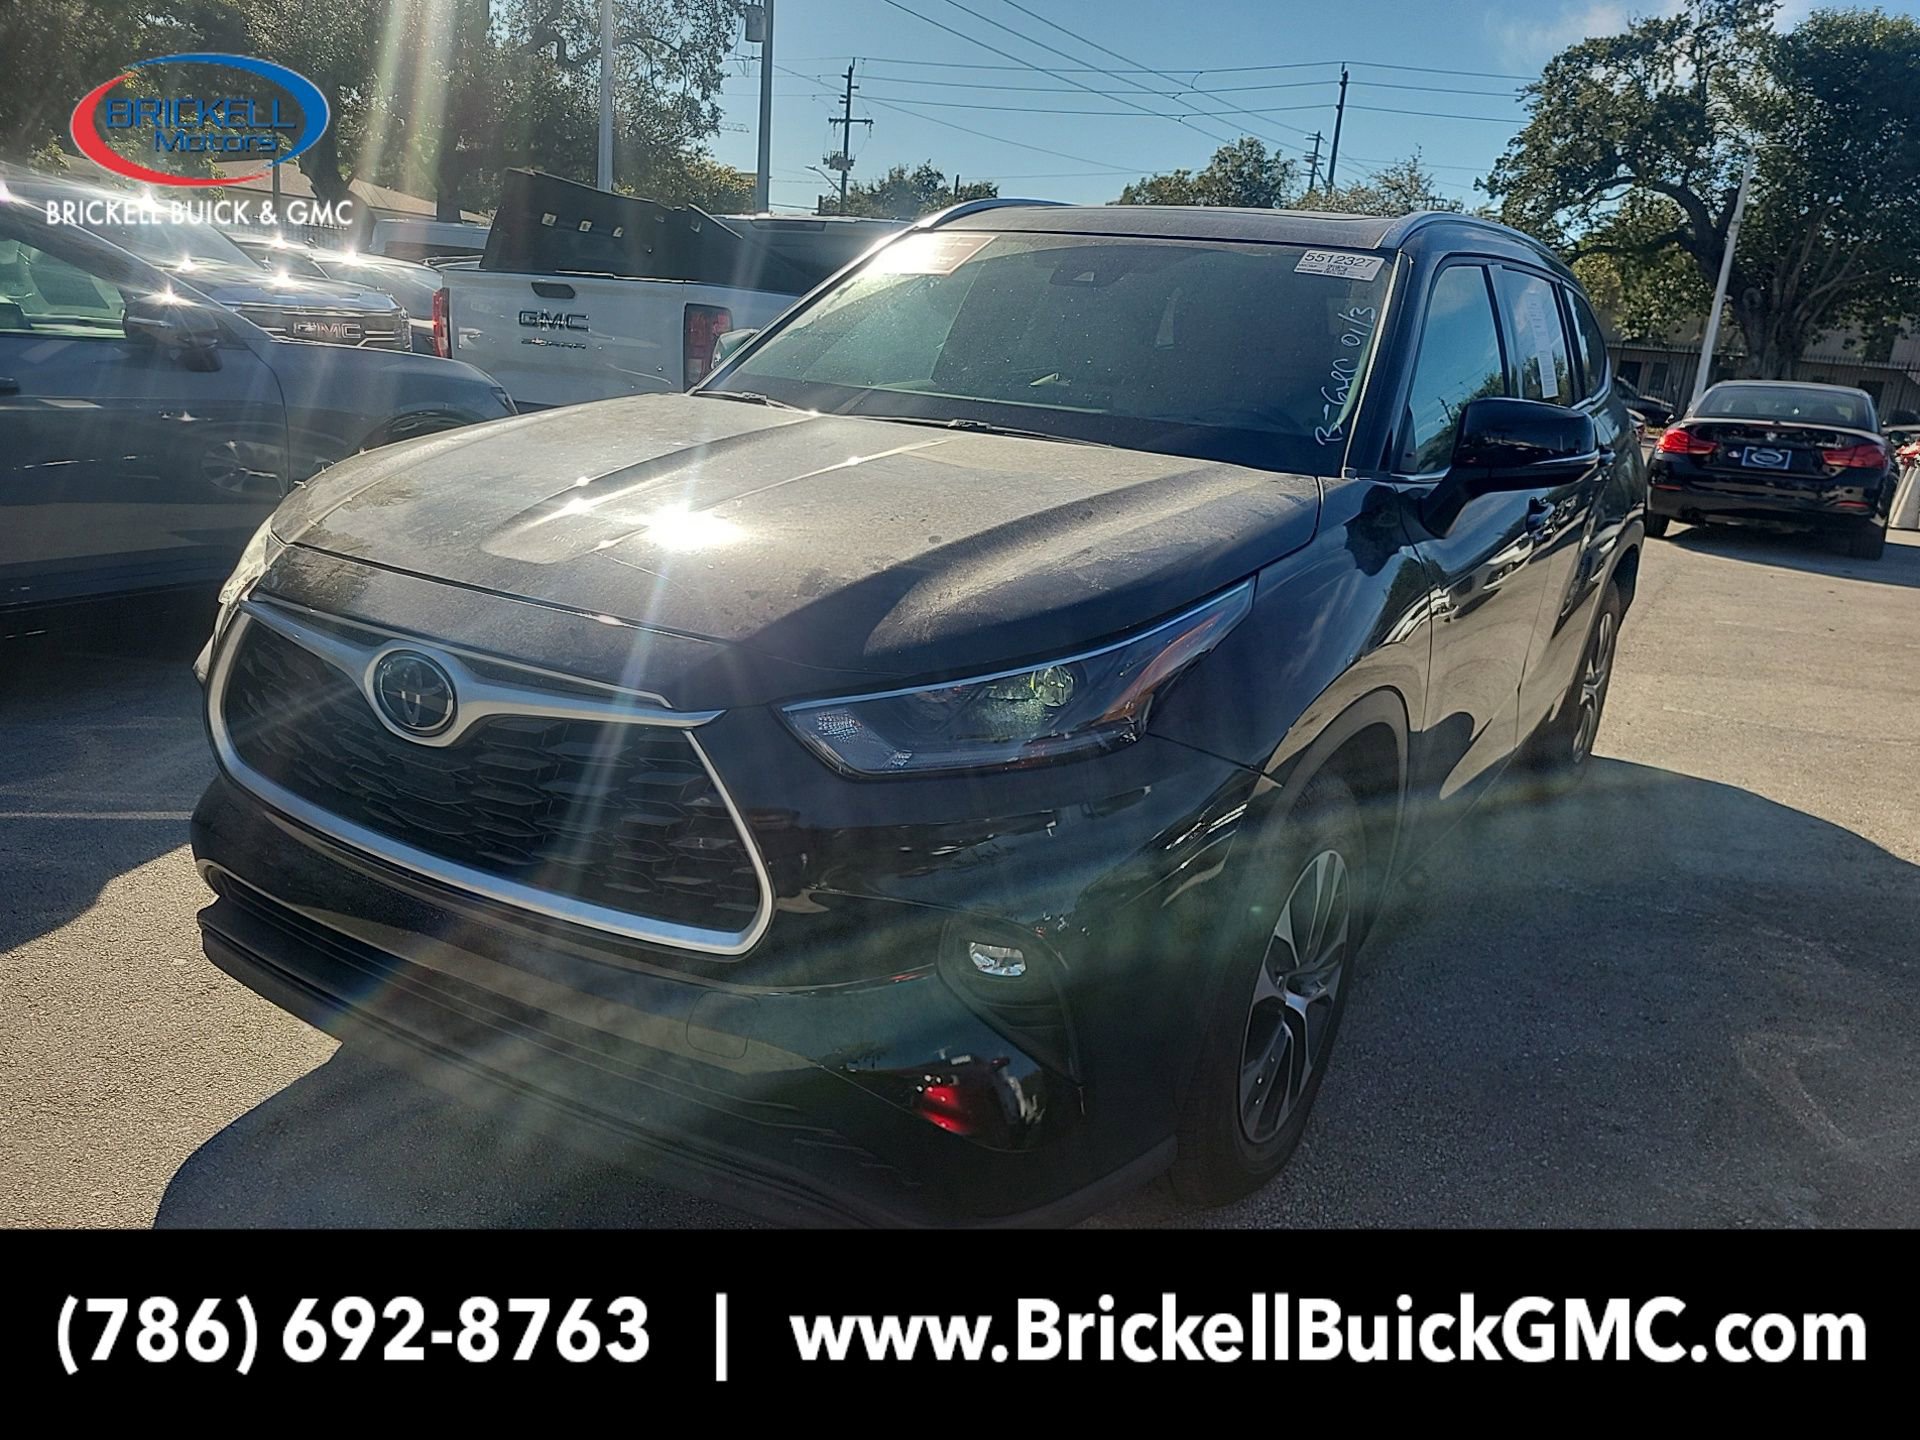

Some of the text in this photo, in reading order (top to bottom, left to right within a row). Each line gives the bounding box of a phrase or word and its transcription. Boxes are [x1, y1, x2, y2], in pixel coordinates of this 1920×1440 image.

[1304, 252, 1376, 268] 5512327
[293, 321, 361, 339] GMC
[519, 310, 589, 332] GMC
